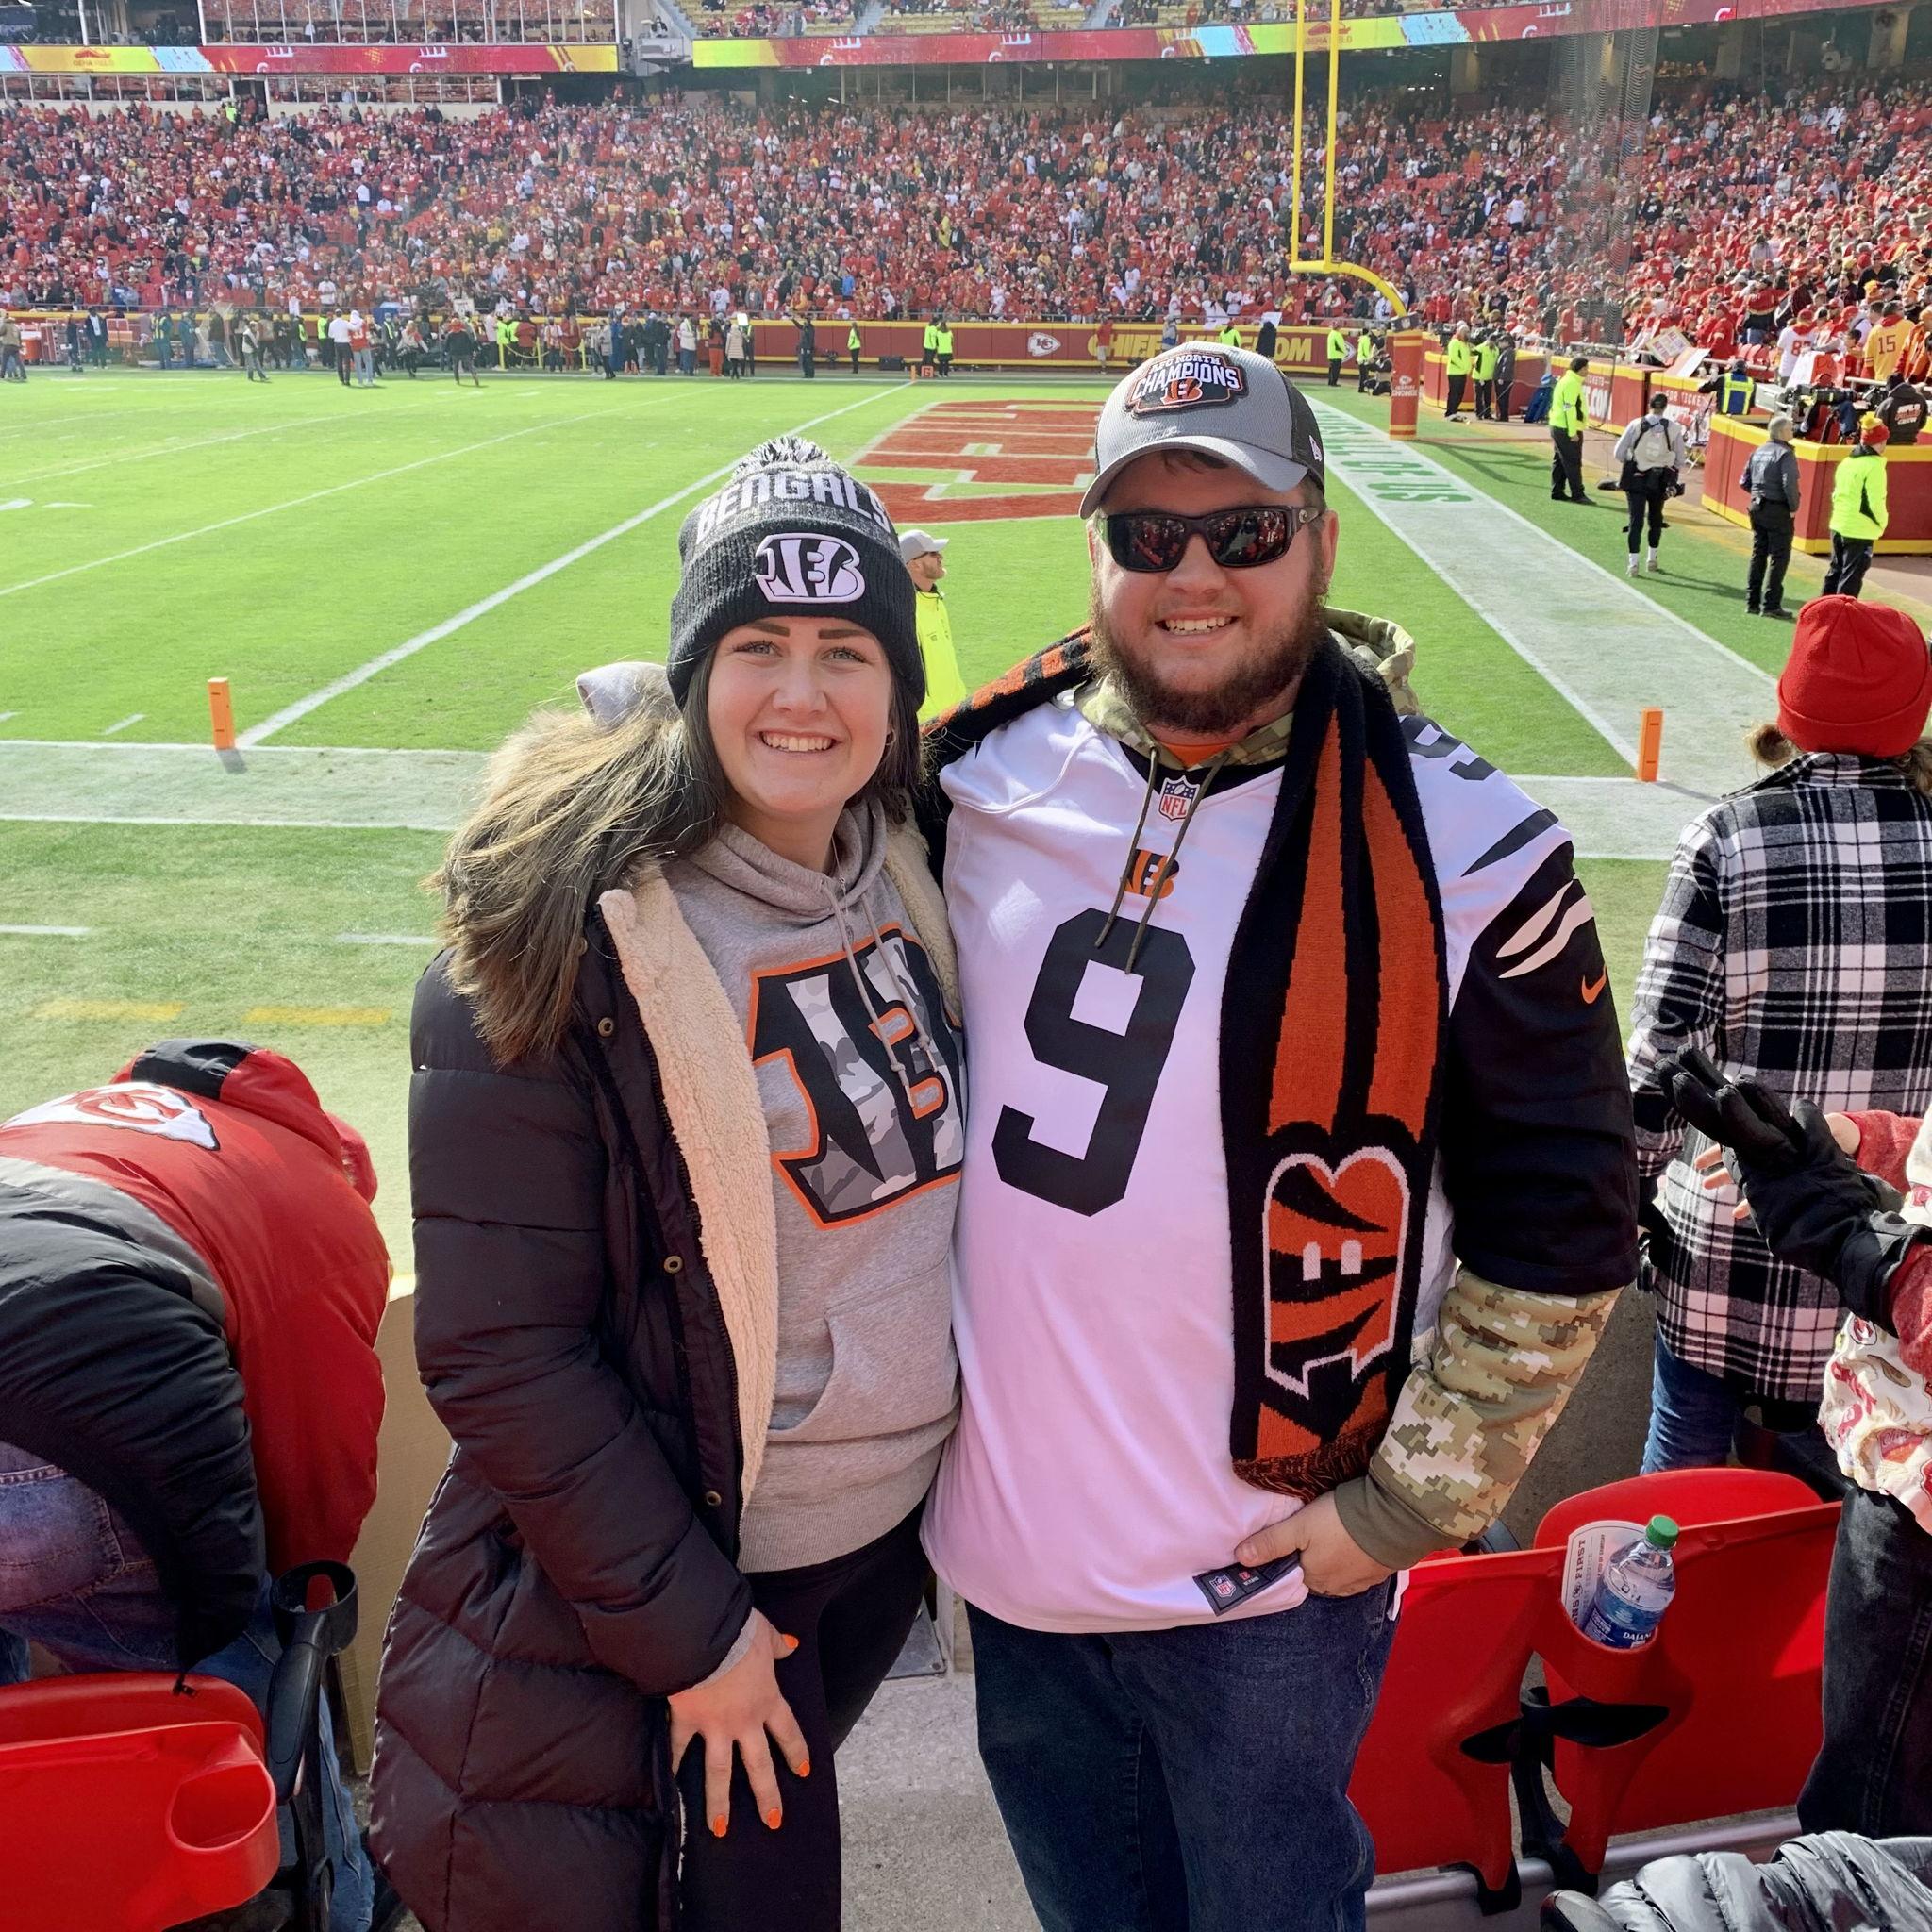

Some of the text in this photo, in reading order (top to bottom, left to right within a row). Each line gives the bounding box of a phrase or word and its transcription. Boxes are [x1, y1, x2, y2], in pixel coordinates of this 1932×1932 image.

[1174, 353, 1222, 366] NORTH
[1878, 335, 1896, 354] 15
[1131, 362, 1241, 402] CHAMPIONS
[1367, 482, 1474, 502] US
[696, 472, 891, 544] BENGALS
[1161, 795, 1187, 816] NFL
[991, 908, 1196, 1217] 9
[1574, 1540, 1586, 1581] FIRST
